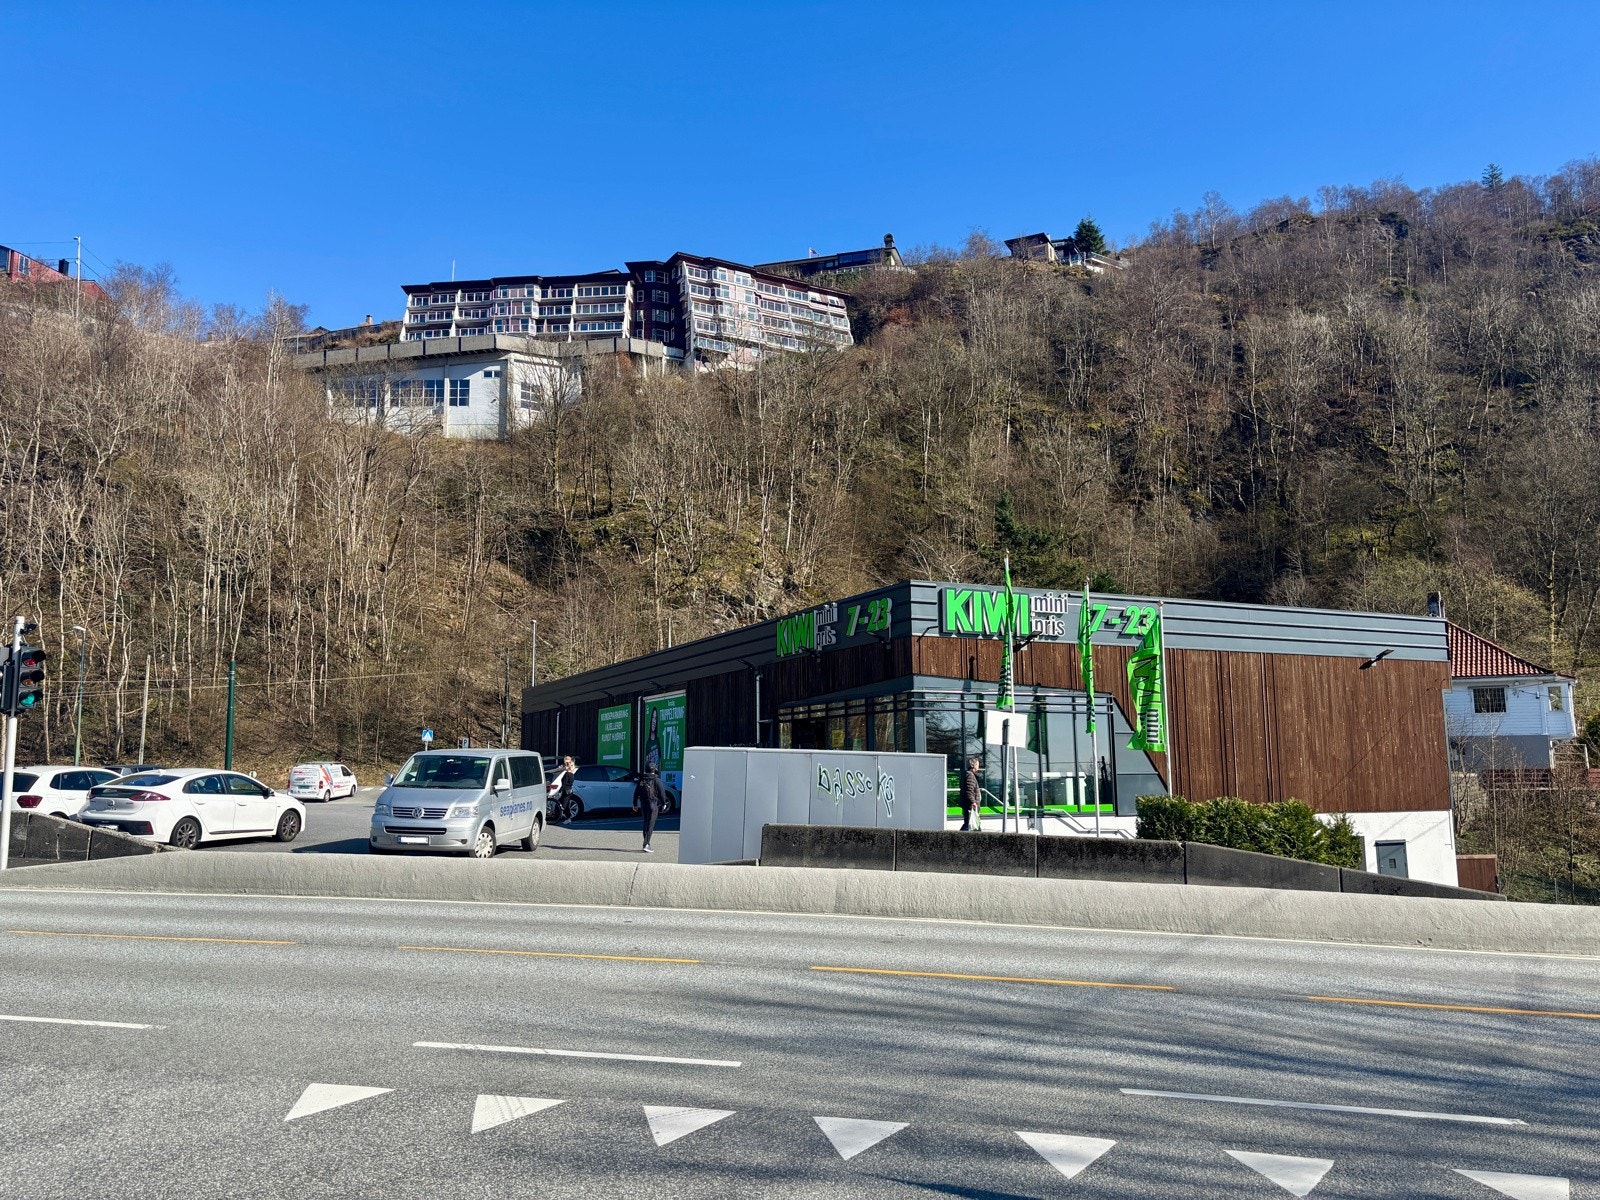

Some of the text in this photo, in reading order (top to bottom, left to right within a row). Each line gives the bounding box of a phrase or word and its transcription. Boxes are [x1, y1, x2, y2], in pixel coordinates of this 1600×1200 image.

[816, 602, 838, 626] mini
[945, 588, 1029, 635] KIWI
[1033, 592, 1068, 613] mini
[776, 612, 815, 656] KIWI
[815, 625, 838, 651] pris
[1146, 708, 1163, 744] mini
